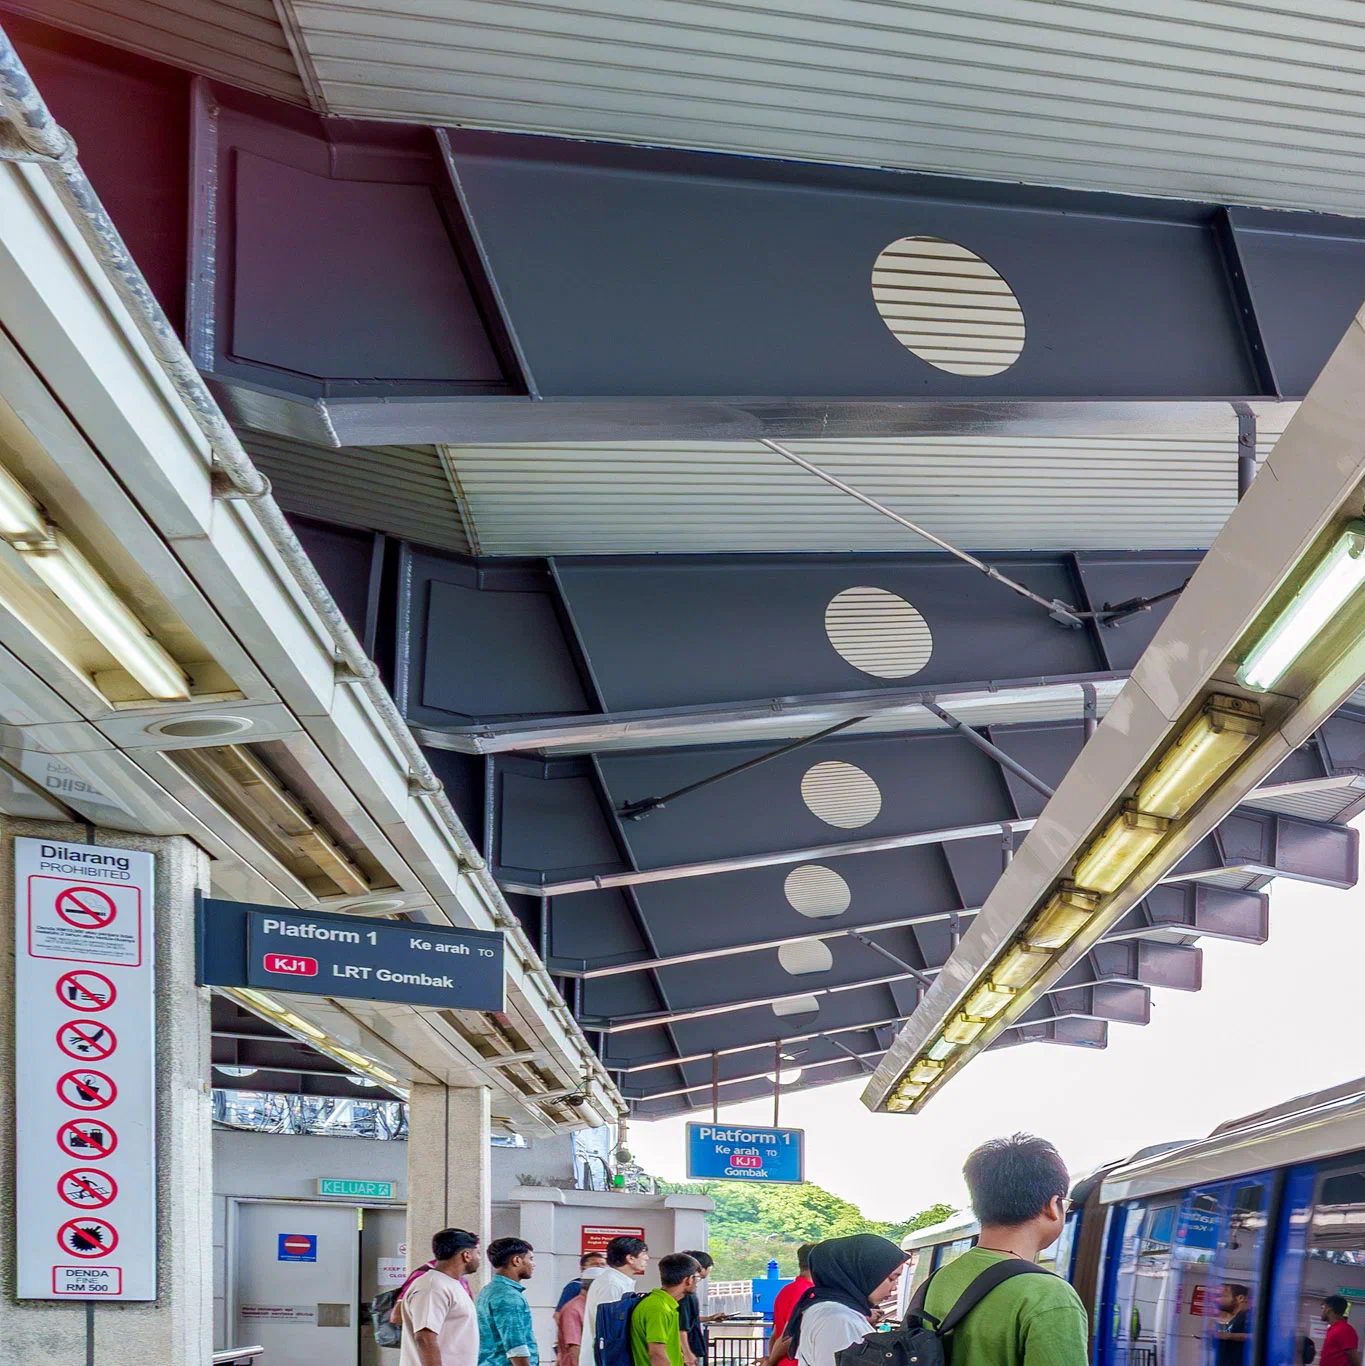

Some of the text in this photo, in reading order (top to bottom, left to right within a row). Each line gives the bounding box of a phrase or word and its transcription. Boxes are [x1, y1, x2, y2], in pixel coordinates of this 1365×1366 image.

[41, 845, 130, 870] Dilarang
[40, 862, 131, 880] PROHIBITED
[263, 919, 378, 946] Platform 1
[410, 938, 494, 958] Ke arah TO
[274, 958, 307, 972] KJ1
[333, 964, 454, 988] LRT Gombak
[700, 1127, 790, 1145] Platform 1
[715, 1145, 778, 1157] Ke arah TO
[736, 1157, 757, 1166] KJ1
[724, 1167, 768, 1178] Gombak
[323, 1181, 376, 1195] KELUAR
[66, 1269, 109, 1277] DENDA
